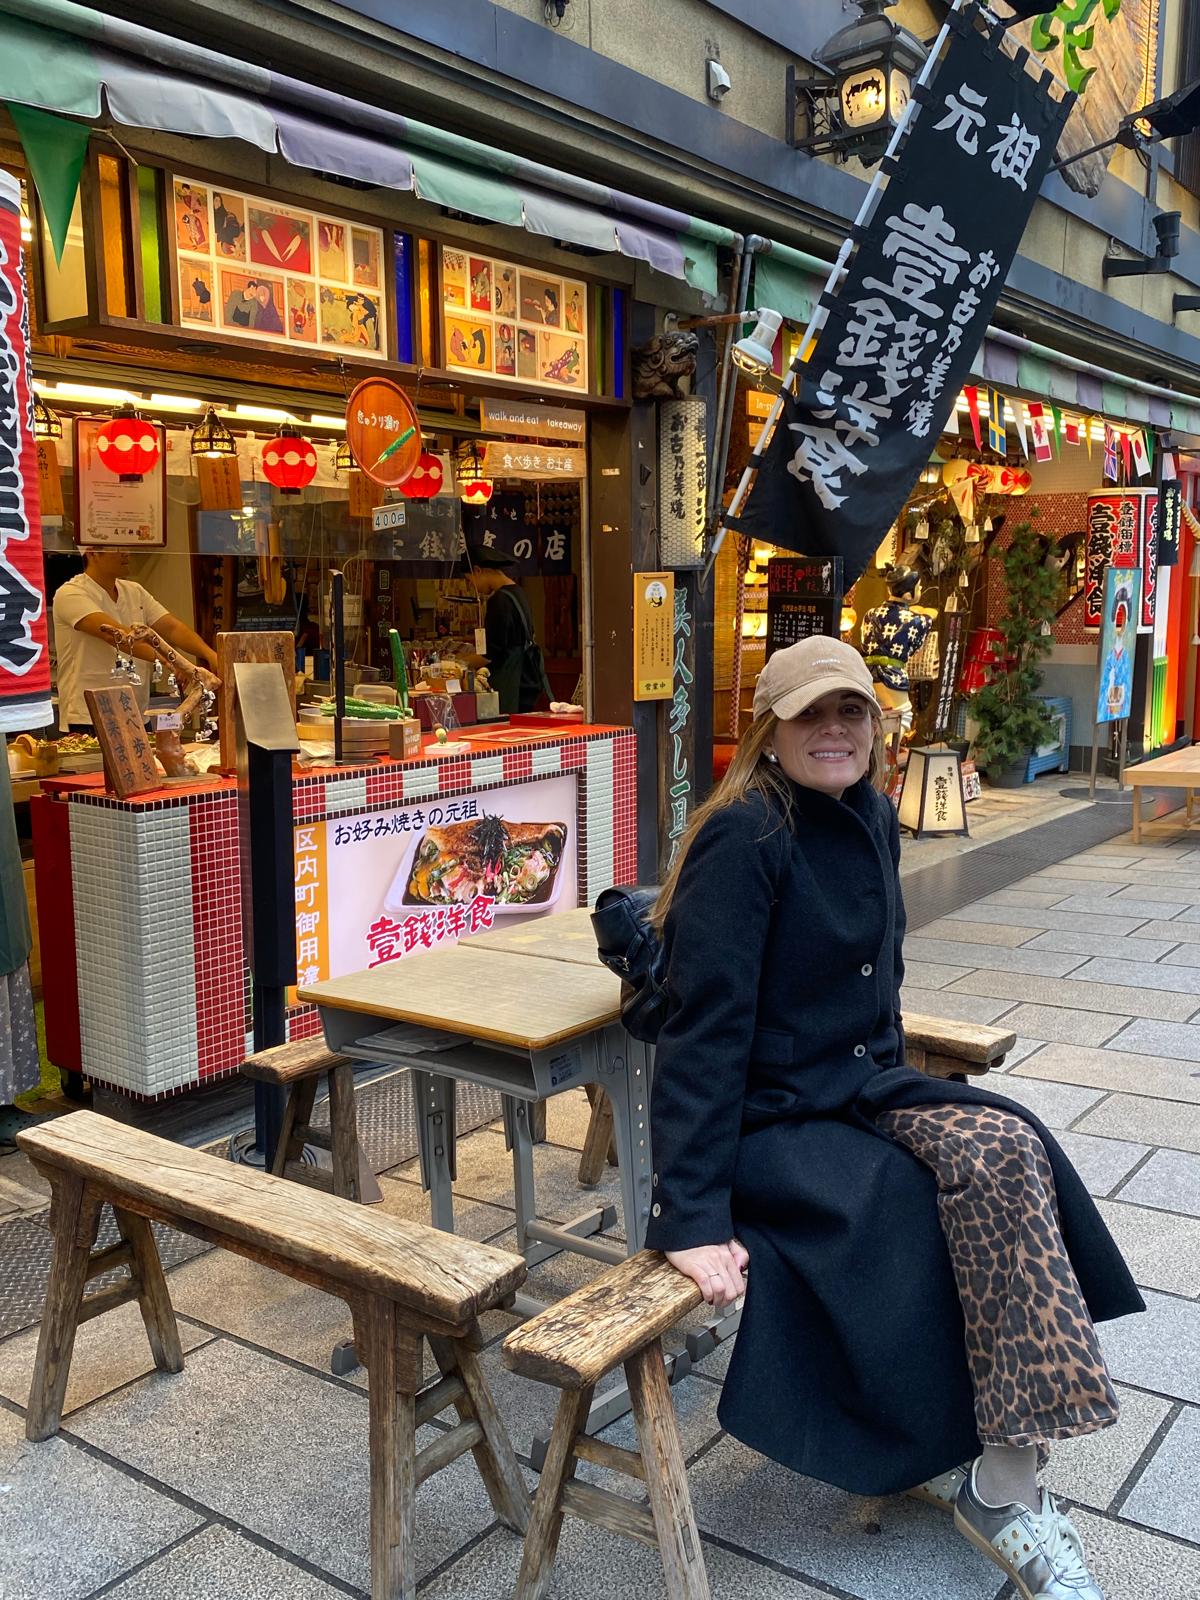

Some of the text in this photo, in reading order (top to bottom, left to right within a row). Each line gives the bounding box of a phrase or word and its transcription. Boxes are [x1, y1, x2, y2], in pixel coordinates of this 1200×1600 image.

[931, 83, 1040, 191] 元祖
[357, 409, 400, 432] きゅうり漬け
[488, 411, 582, 433] walk and eat takeaway
[502, 453, 573, 472] 食べ歩き お土産
[375, 512, 405, 528] 400円
[769, 564, 793, 578] FREE
[644, 681, 667, 692] 営業中
[334, 800, 479, 846] お好み焼きの元祖
[294, 827, 321, 988] 区内町御用達
